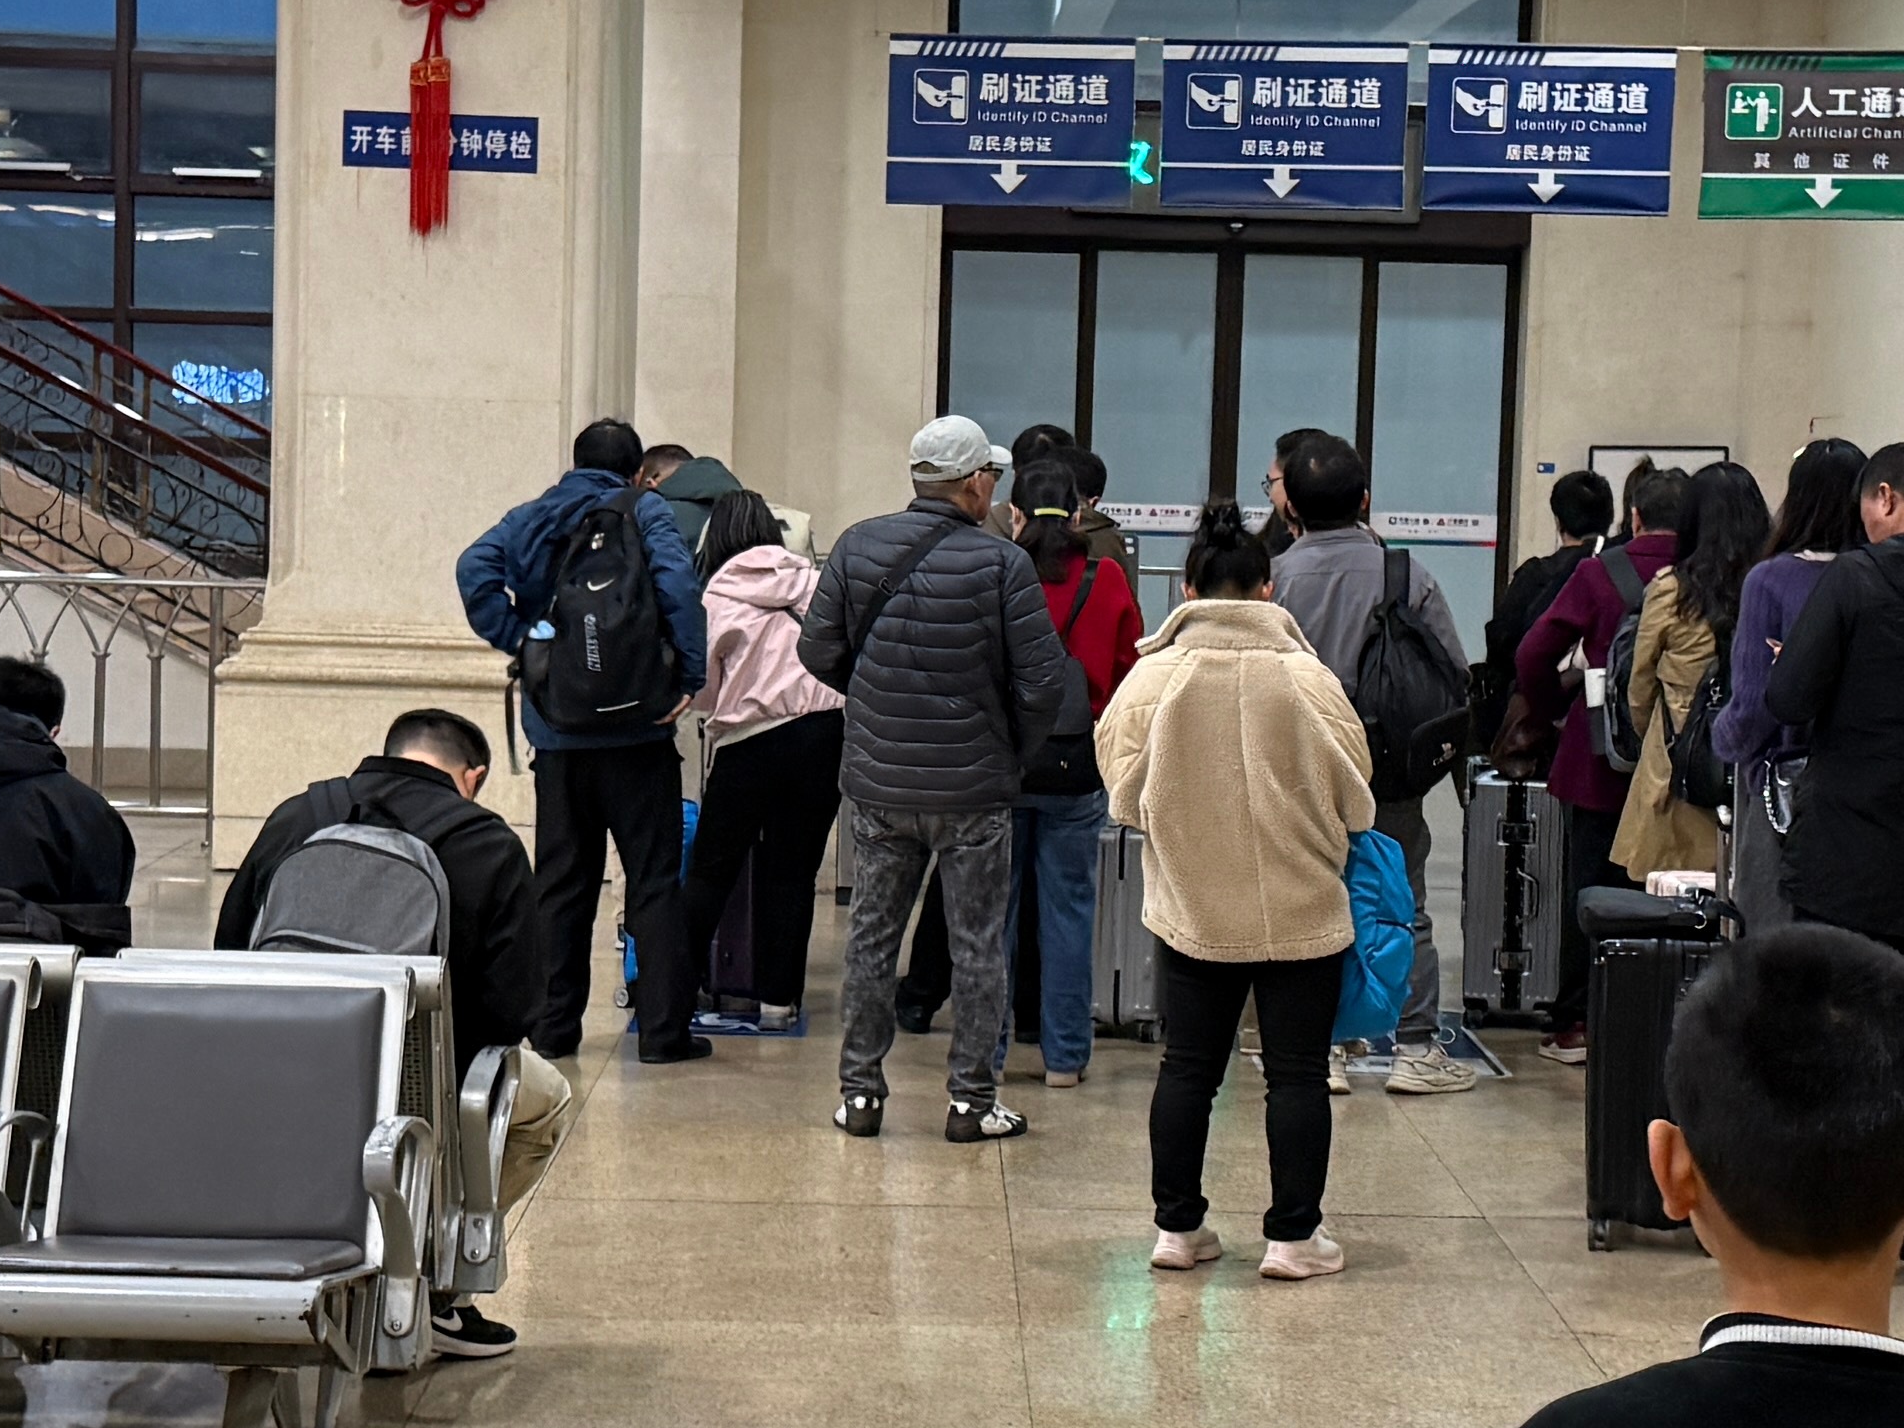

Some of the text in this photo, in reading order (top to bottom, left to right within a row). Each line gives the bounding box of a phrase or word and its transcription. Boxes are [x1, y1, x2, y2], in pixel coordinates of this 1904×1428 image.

[978, 73, 1109, 108] 刷证通道
[1251, 76, 1382, 110] 刷证通道
[1516, 81, 1649, 117] 刷证通道
[1034, 112, 1047, 124] ID
[1050, 112, 1108, 125] Channel
[1307, 115, 1320, 128] ID
[1323, 116, 1381, 129] Channel
[1515, 120, 1647, 135] Identify ID Channel
[1788, 127, 1858, 141] Artificial
[968, 135, 1052, 153] 居民身份证
[1241, 139, 1326, 158] 居民身份证
[1505, 144, 1592, 163] 居民身份证
[1753, 152, 1891, 172] 其他证件
